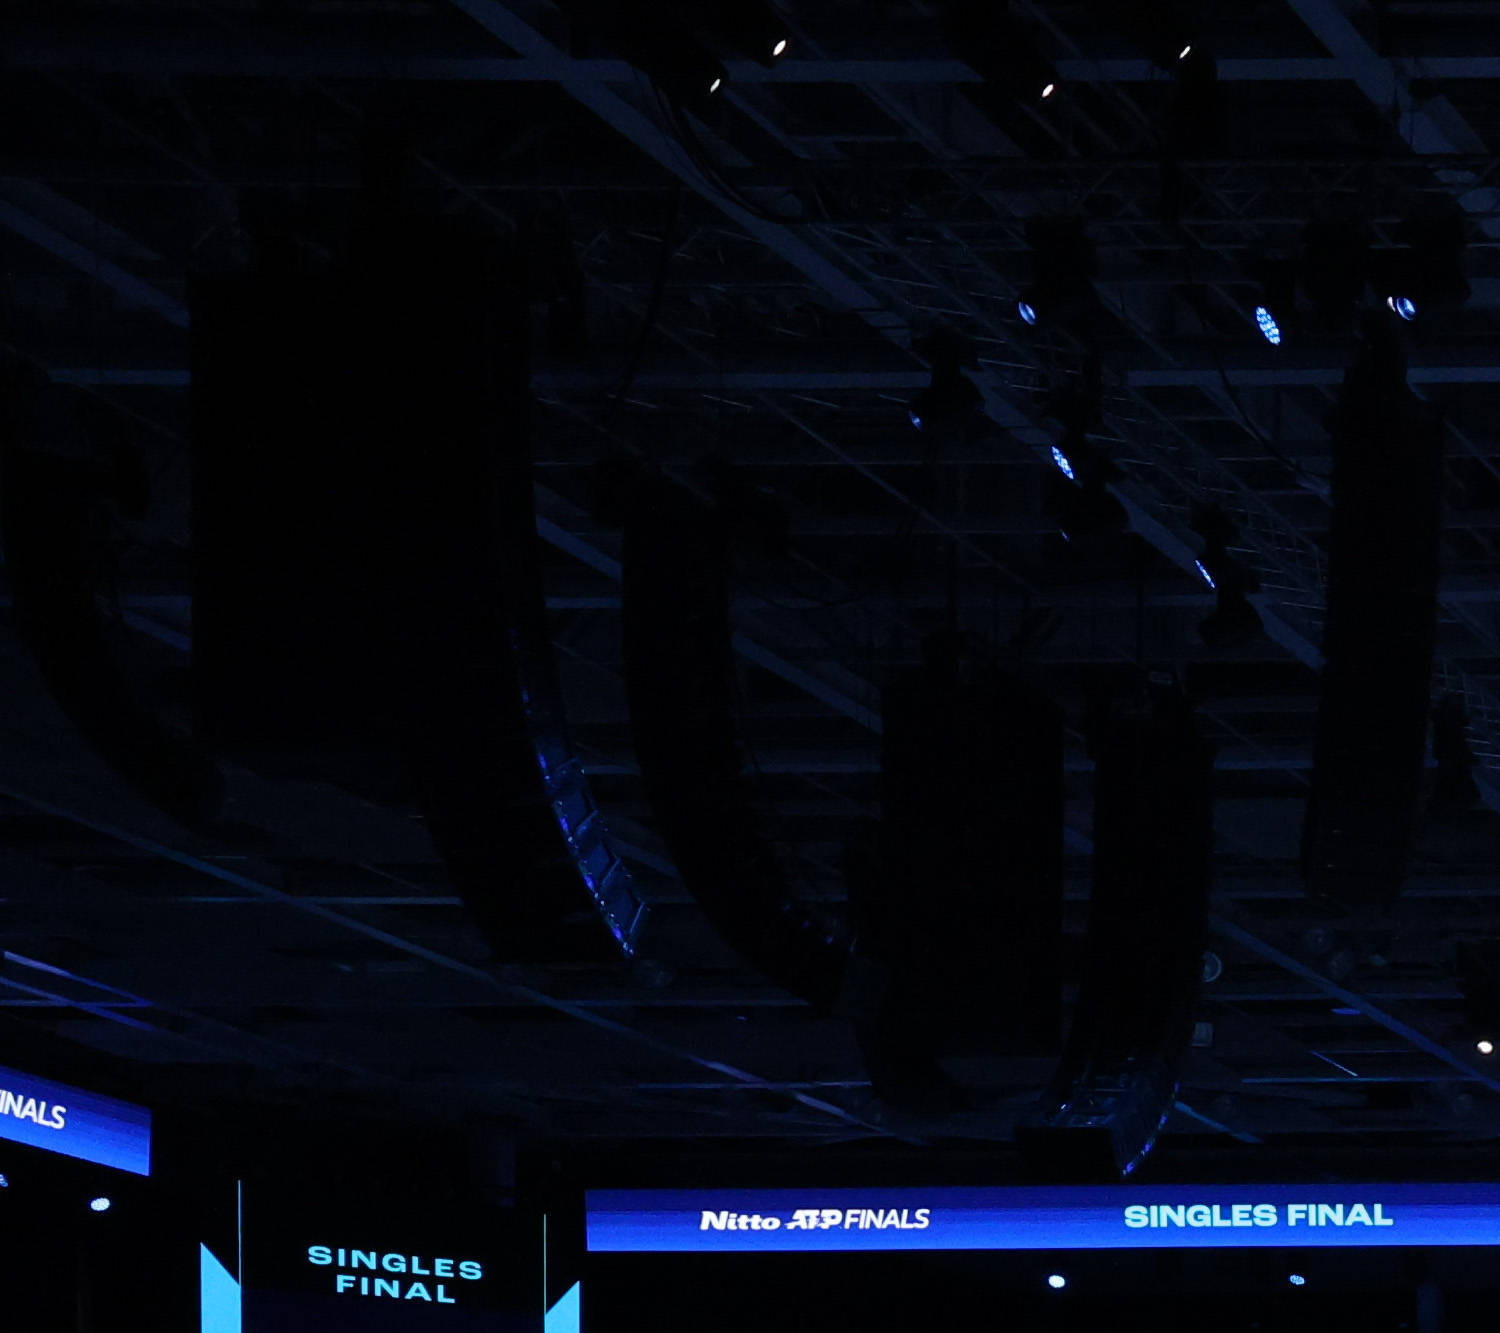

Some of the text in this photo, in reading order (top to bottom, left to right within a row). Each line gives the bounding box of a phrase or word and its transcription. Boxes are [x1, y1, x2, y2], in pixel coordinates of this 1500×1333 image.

[0, 1089, 67, 1130] INALS
[700, 1209, 930, 1231] Nitto ATP FINALS
[1124, 1203, 1394, 1228] SINGLES FINAL
[308, 1245, 483, 1281] SINGLES
[336, 1274, 455, 1304] FINAL
